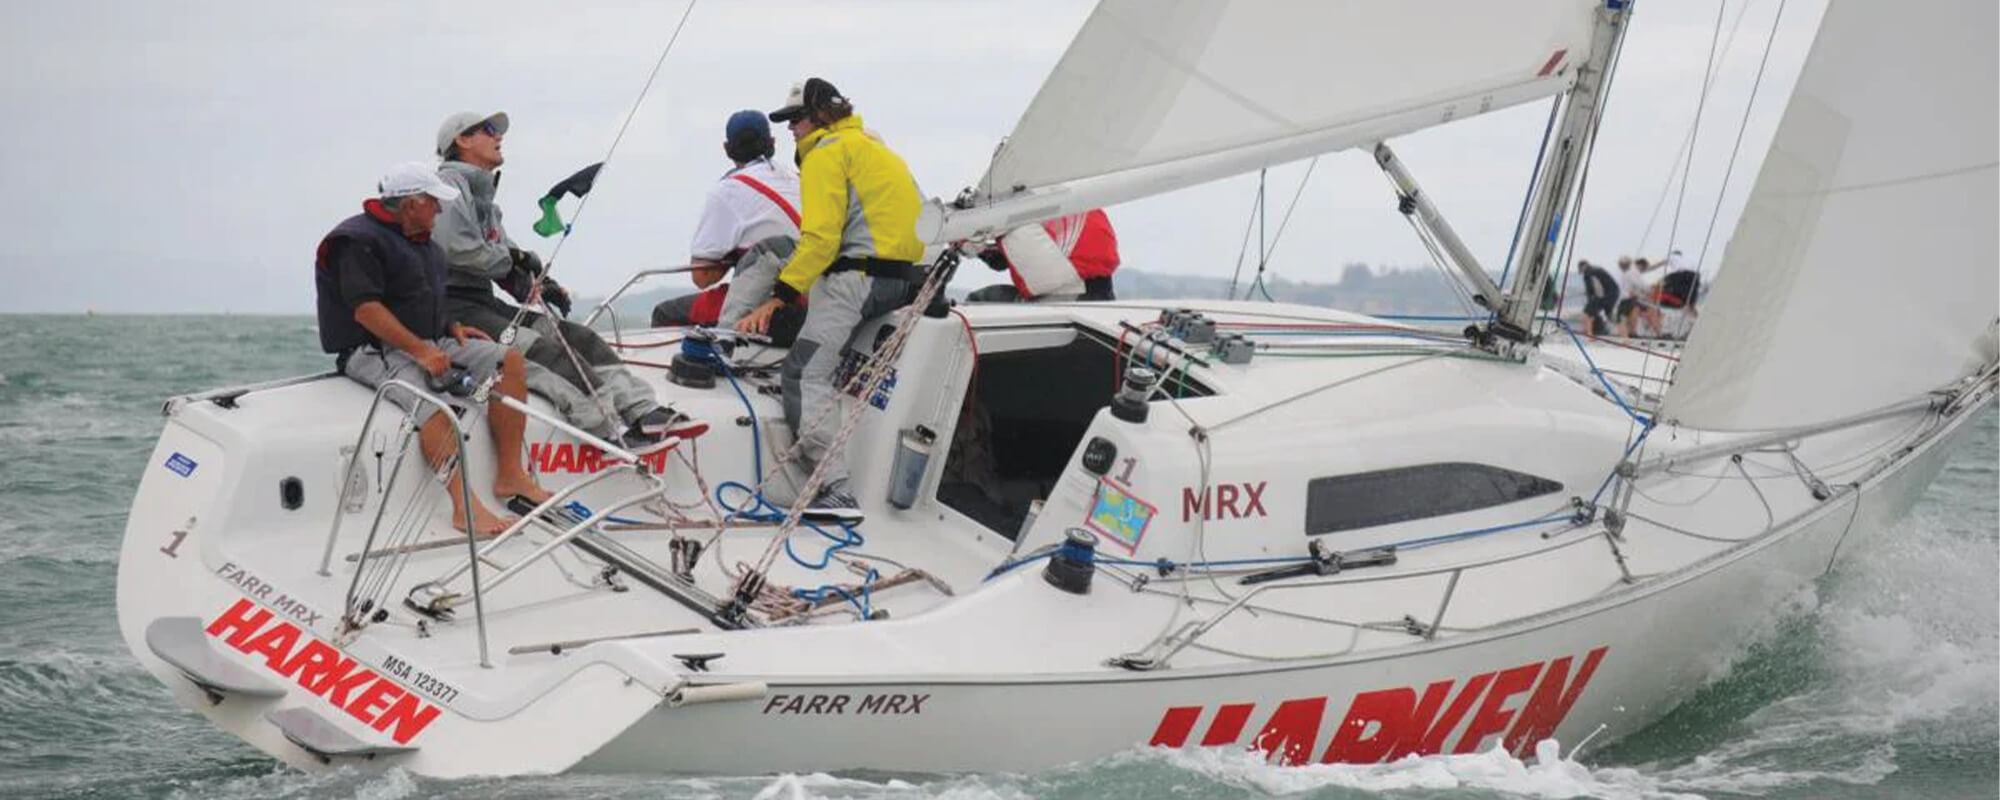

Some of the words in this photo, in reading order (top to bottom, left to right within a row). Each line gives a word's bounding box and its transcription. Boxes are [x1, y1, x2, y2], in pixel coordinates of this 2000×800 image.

[1114, 457, 1137, 487] 1
[1183, 481, 1268, 523] MRX
[160, 531, 188, 558] 1
[216, 561, 273, 600] FARR
[275, 595, 324, 627] MRX
[206, 597, 442, 744] HARKEN
[383, 654, 411, 681] MSA
[414, 674, 459, 704] 123377
[763, 694, 850, 714] FARR
[855, 694, 930, 714] MRX
